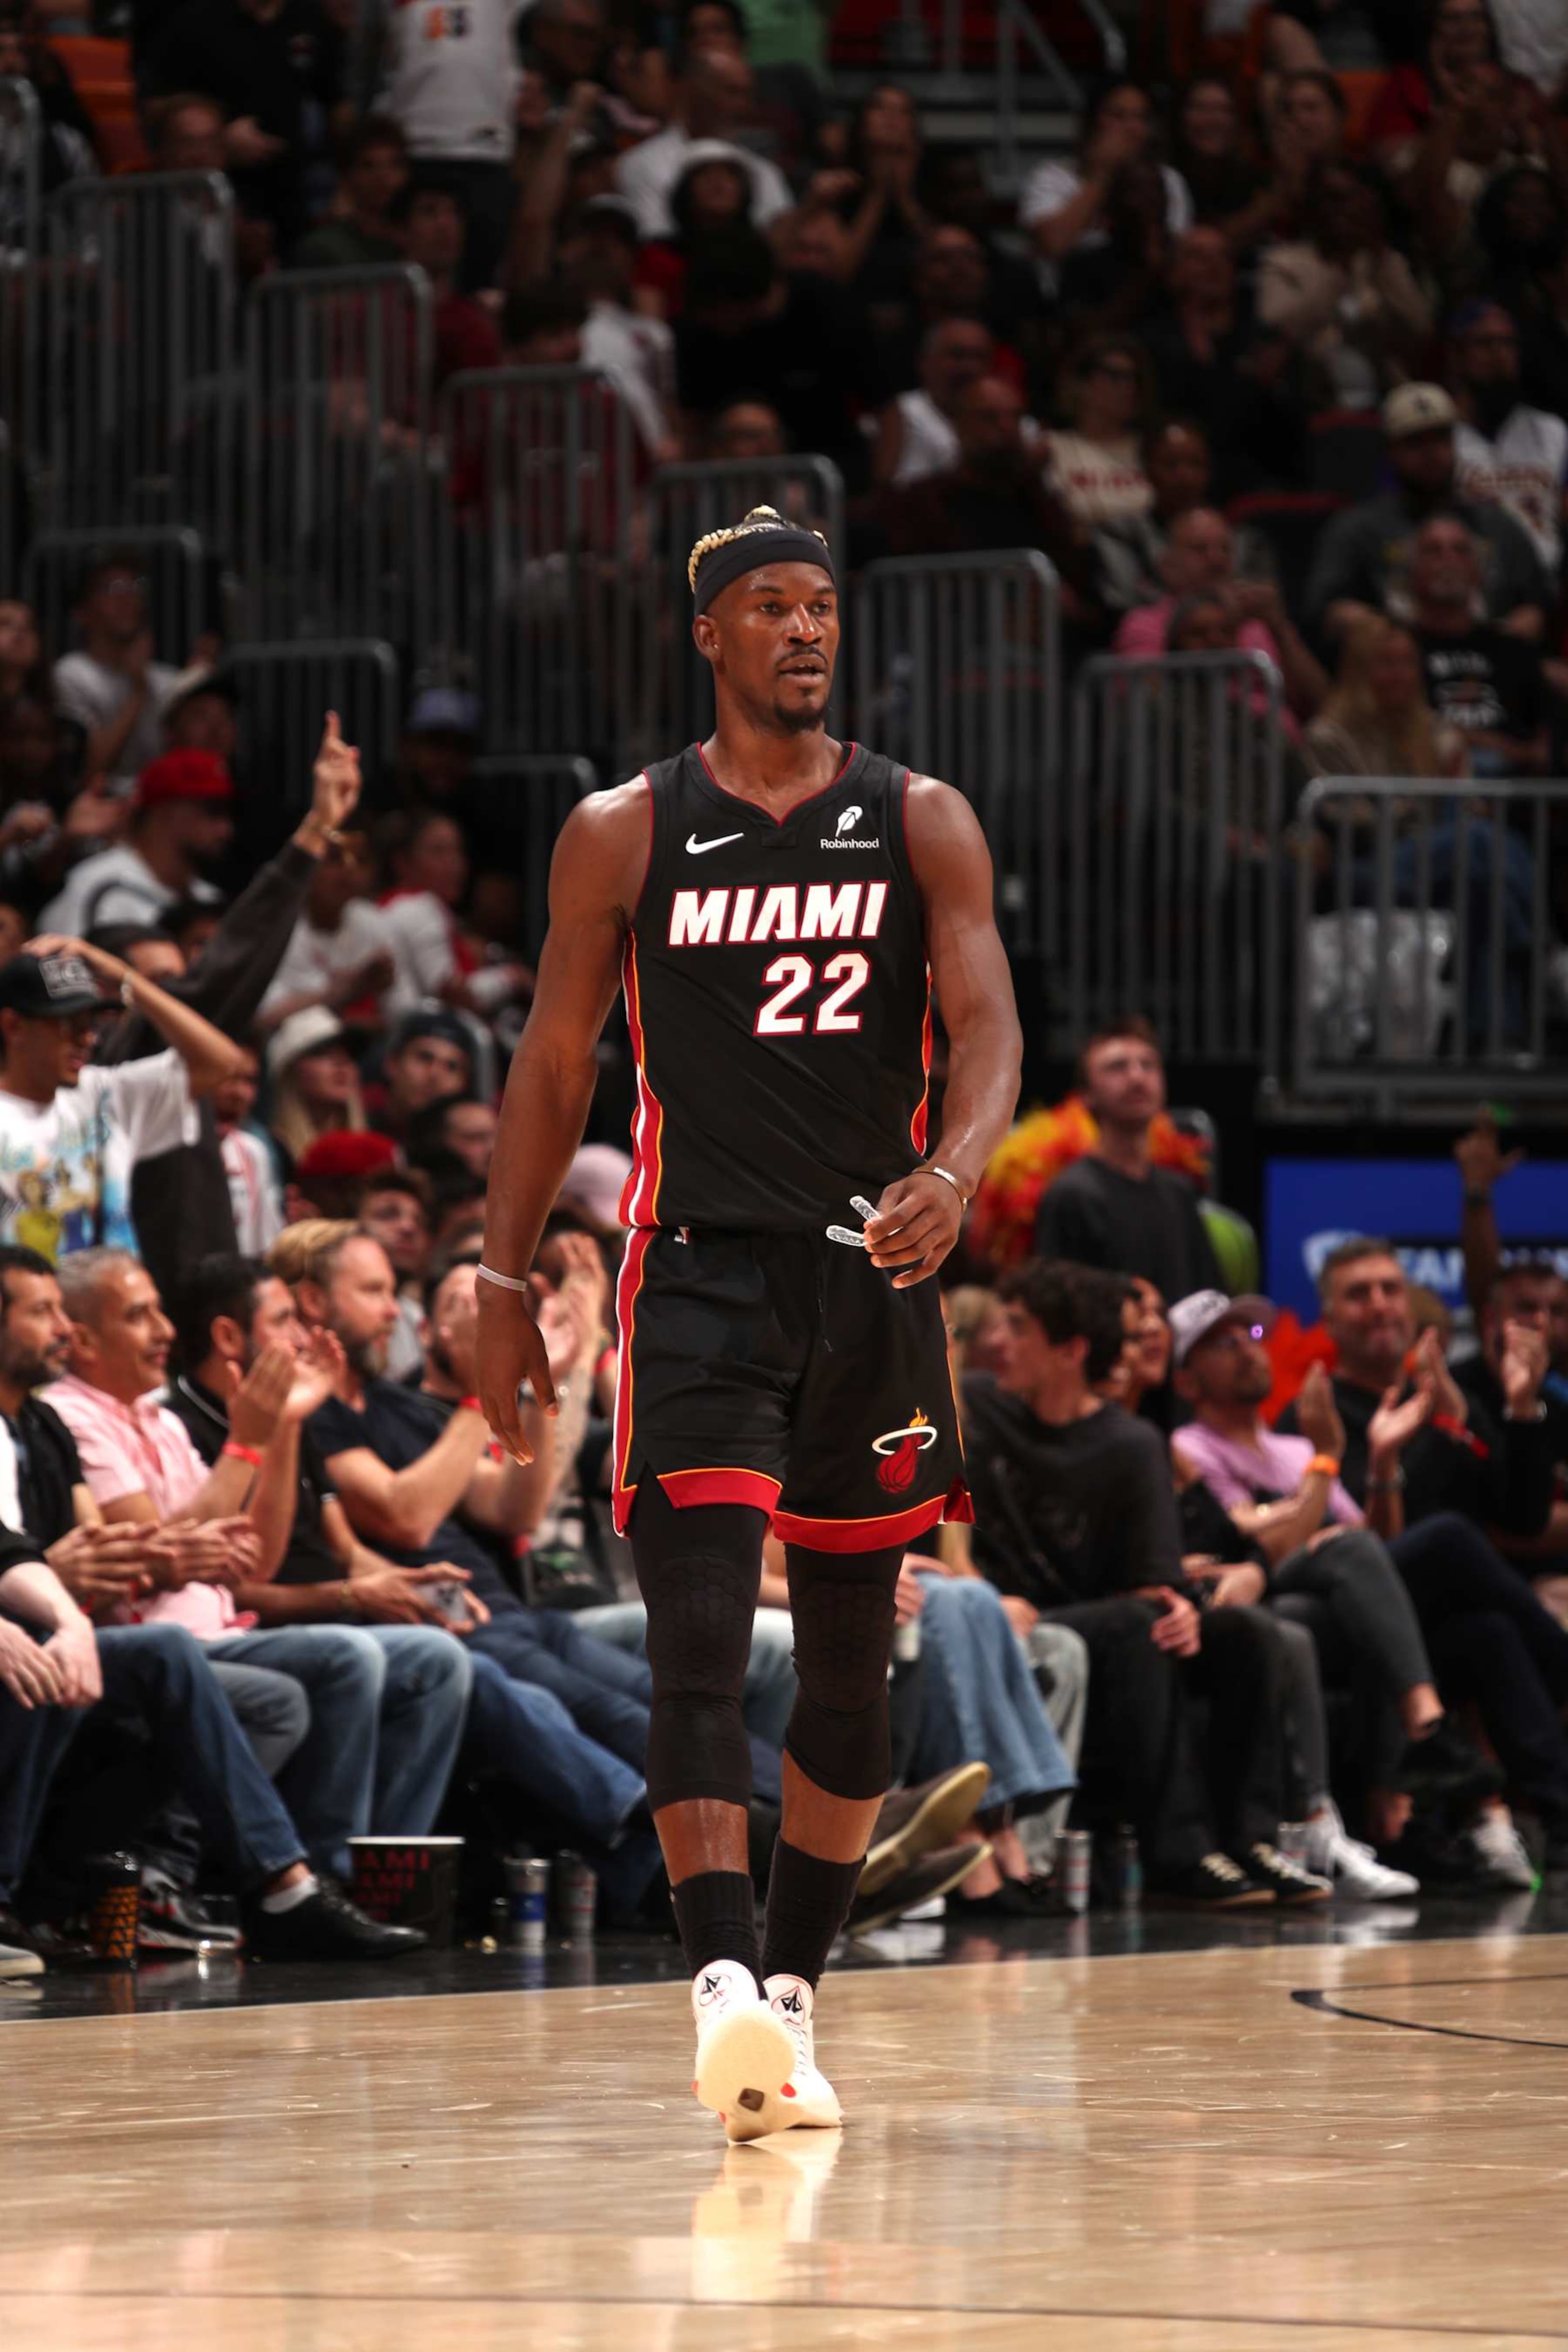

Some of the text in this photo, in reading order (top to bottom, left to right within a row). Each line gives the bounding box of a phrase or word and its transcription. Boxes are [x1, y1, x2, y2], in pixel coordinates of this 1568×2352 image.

[820, 837, 880, 849] Robinhood
[668, 881, 890, 947] MIAMI
[754, 950, 872, 1035] 22
